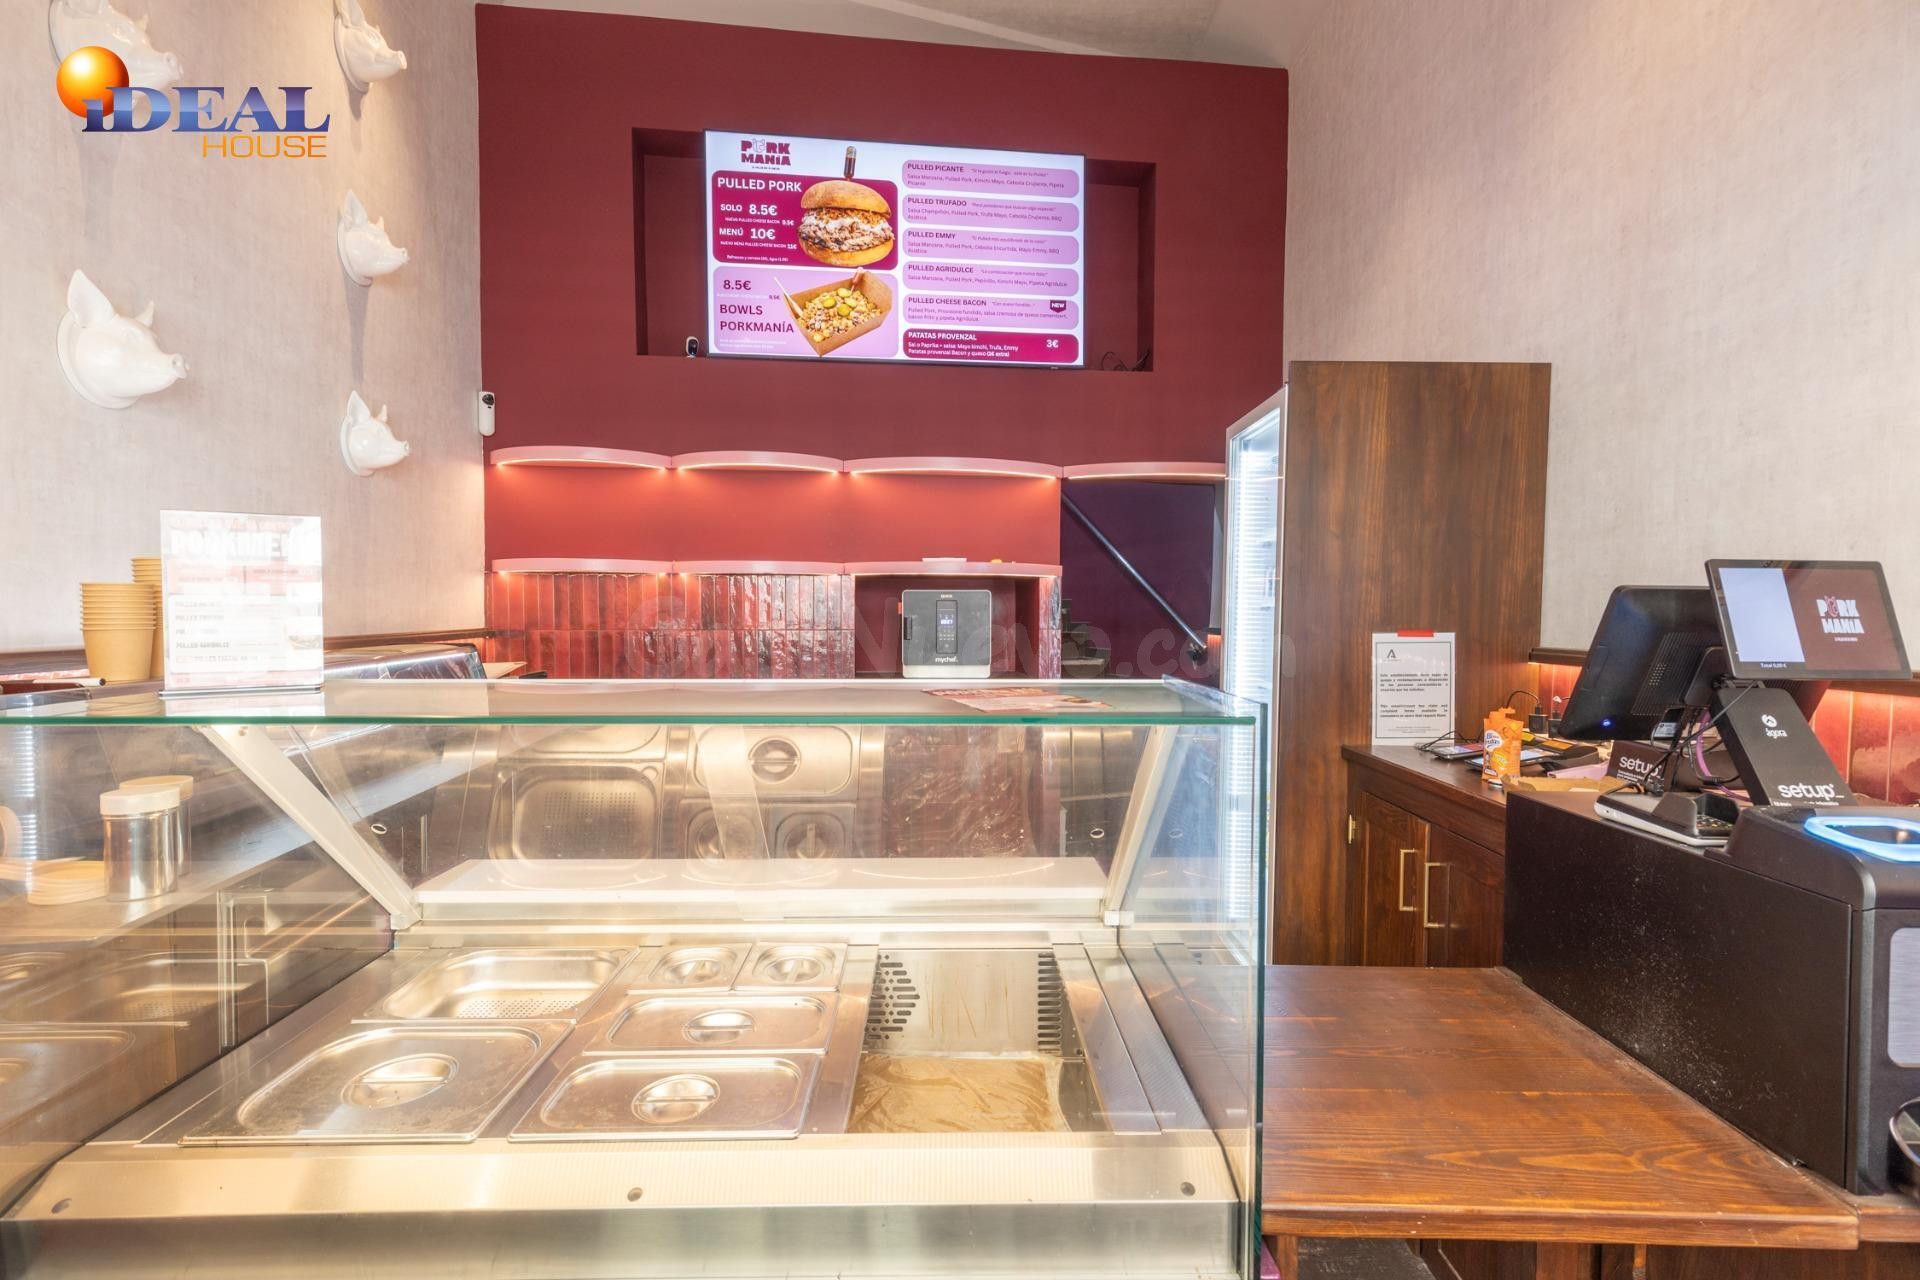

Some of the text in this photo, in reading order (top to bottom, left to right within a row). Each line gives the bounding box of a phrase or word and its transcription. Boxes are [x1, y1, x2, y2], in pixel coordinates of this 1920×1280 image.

[718, 177, 802, 192] PULLED PORK
[720, 204, 777, 215] SOLO 8.5€
[719, 227, 775, 239] MENÚ 10€
[723, 280, 752, 290] 8.5€
[719, 304, 763, 315] BOWLS
[720, 320, 794, 333] PORKMANÍA
[1046, 339, 1059, 348] 3€
